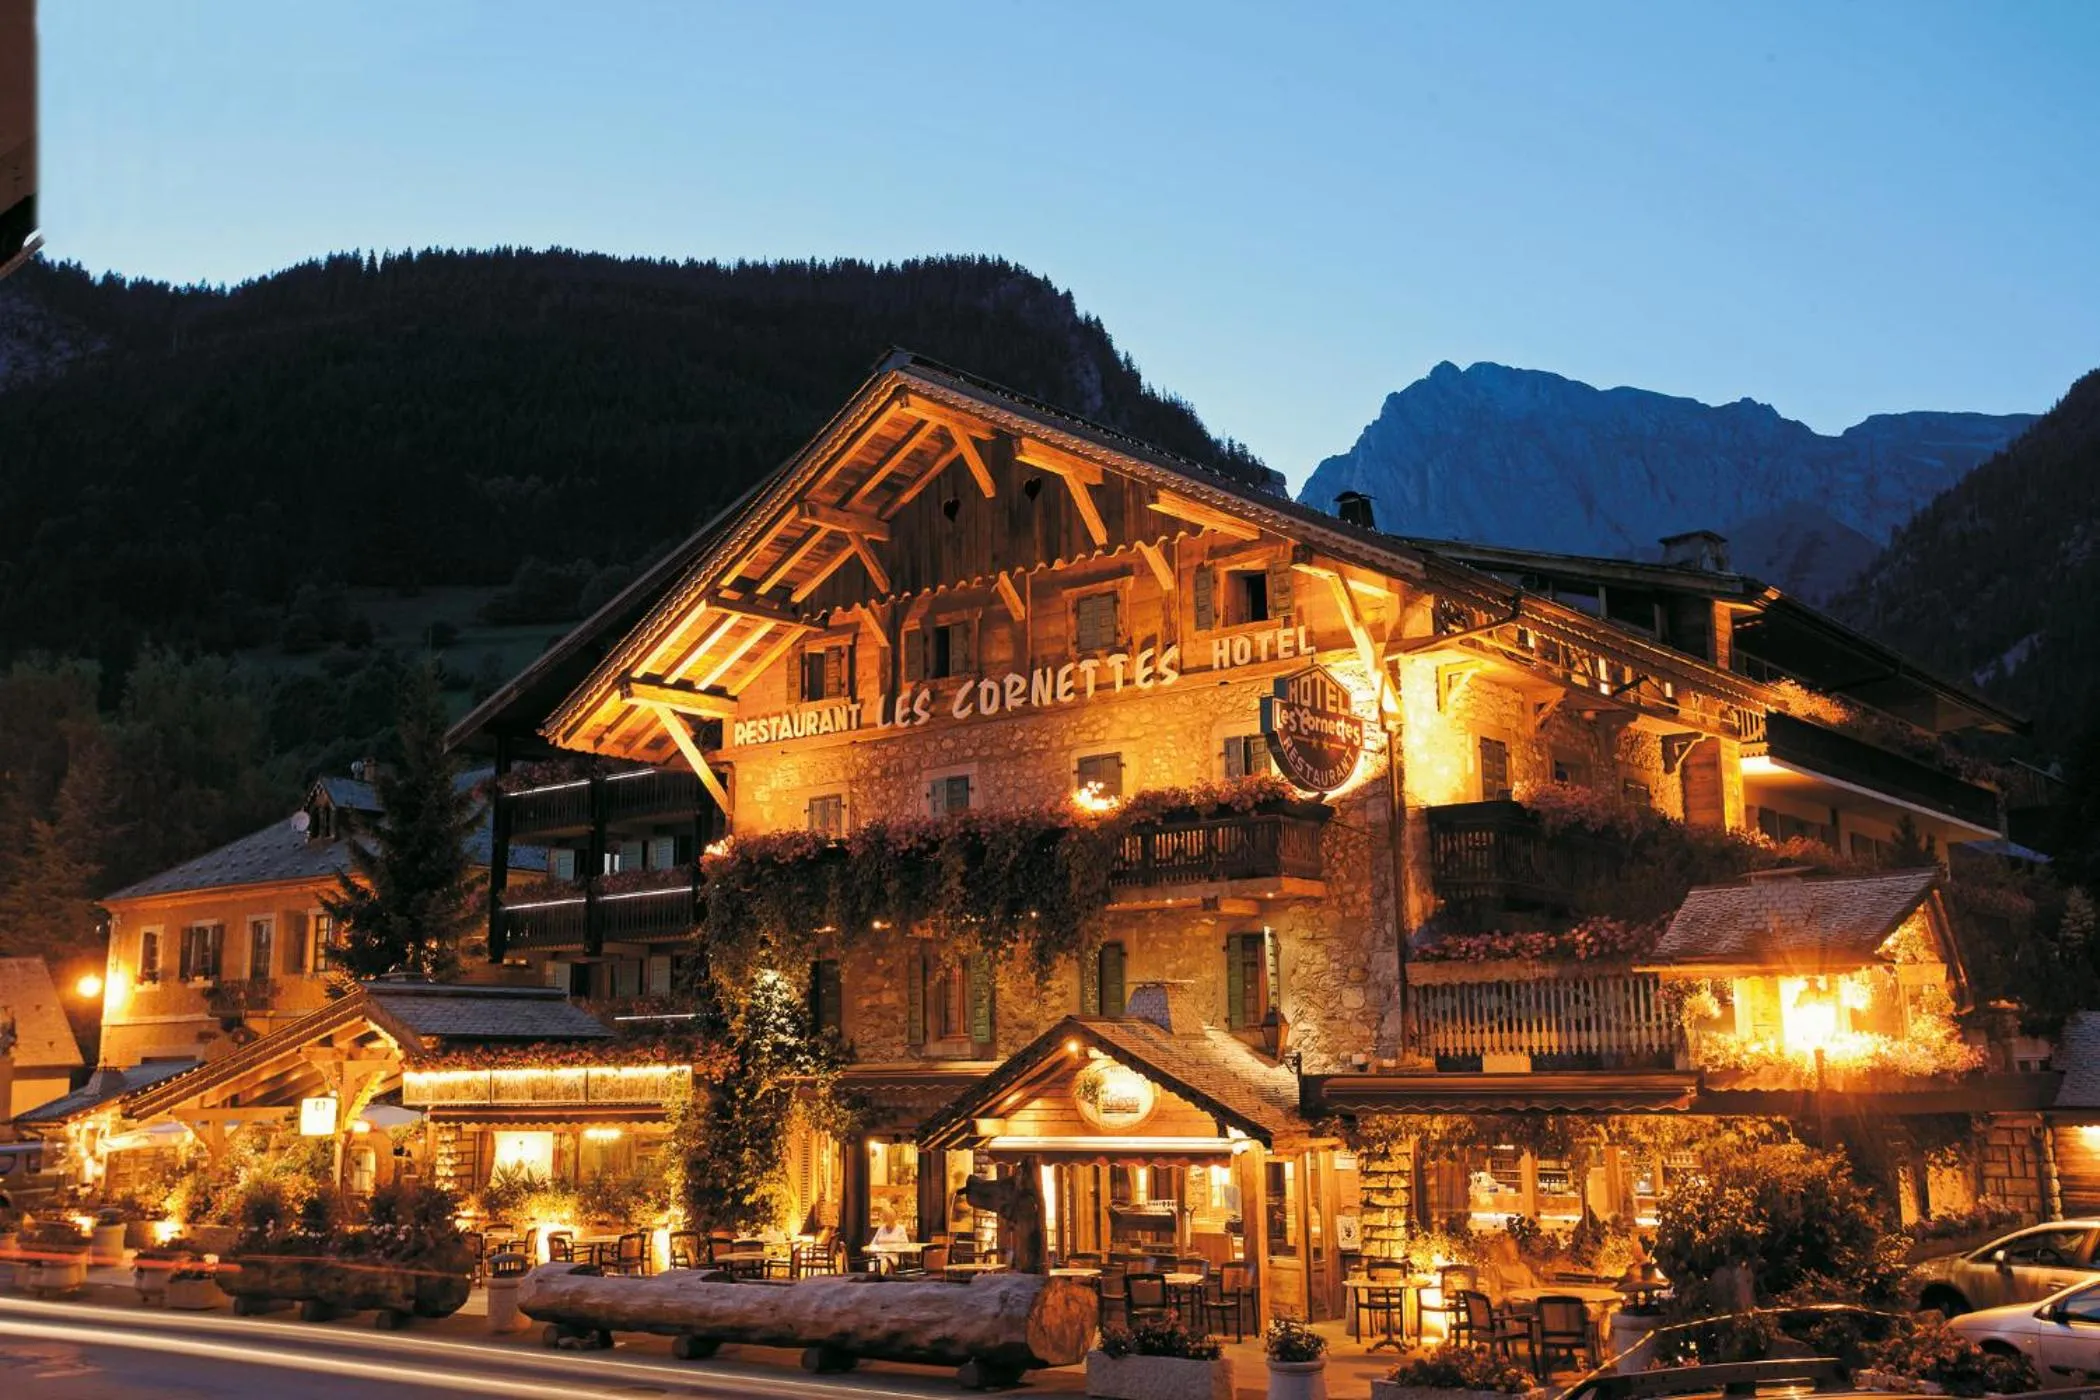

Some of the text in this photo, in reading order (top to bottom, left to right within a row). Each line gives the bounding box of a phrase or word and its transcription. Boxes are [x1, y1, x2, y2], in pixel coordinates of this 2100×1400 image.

[734, 625, 1316, 746] RESTAURANT LES CORNETTES HOTEL
[1288, 672, 1350, 716] HOTEL
[1275, 700, 1297, 733] Les
[1283, 736, 1355, 787] RESTAURANT
